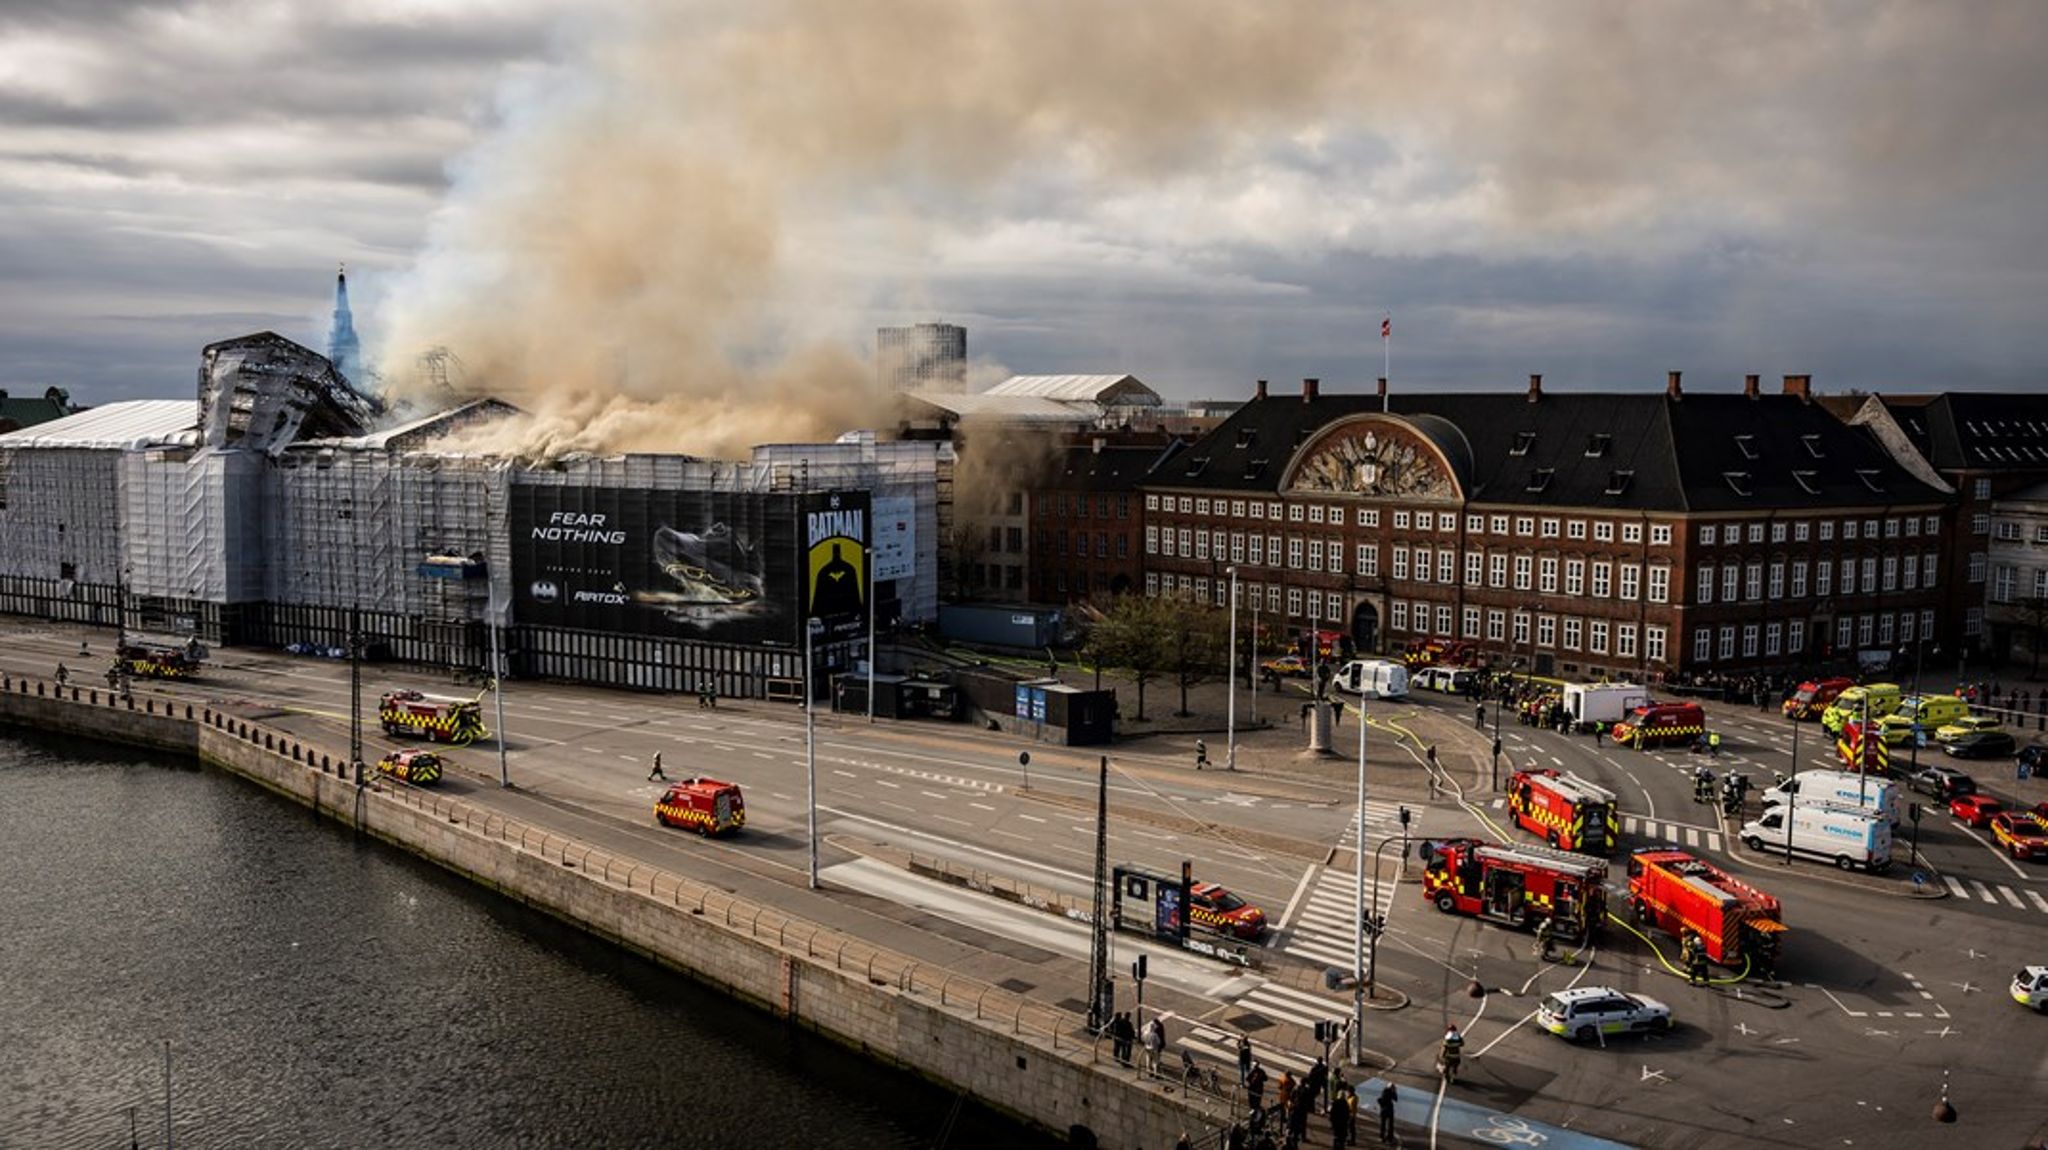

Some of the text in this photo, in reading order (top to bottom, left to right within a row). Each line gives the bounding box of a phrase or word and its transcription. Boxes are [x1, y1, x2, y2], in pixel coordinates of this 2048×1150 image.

[551, 512, 606, 527] FEAR
[532, 527, 626, 544] NOTHING
[808, 509, 863, 548] BATMAN
